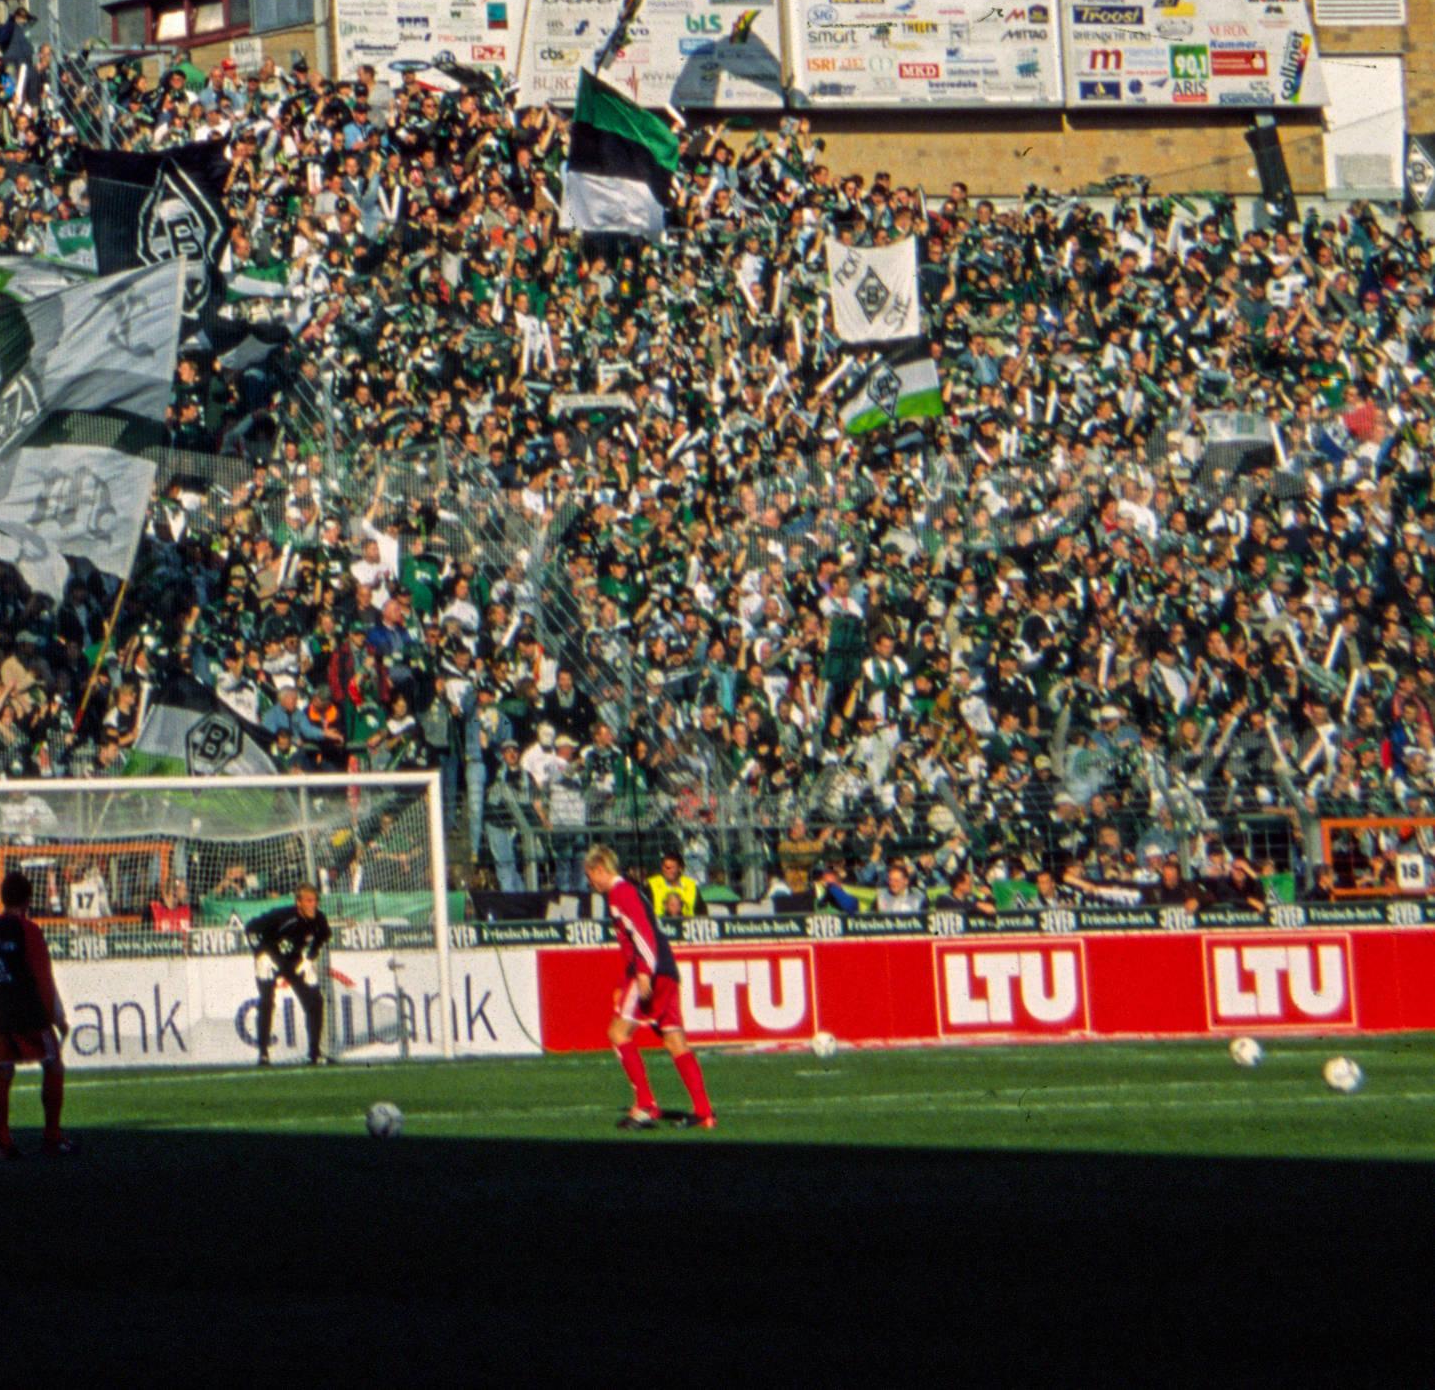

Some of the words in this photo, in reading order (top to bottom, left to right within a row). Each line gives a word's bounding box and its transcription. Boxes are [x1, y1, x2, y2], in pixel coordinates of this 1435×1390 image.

[808, 29, 857, 44] smart
[903, 65, 938, 77] MKD
[68, 933, 108, 959] JEVER
[191, 929, 236, 955] JEVER
[340, 924, 385, 950] JEVER
[565, 921, 604, 945] JEVER
[682, 918, 721, 942] JEVER
[805, 914, 842, 938] JEVER
[928, 912, 964, 935] JEVER
[1040, 910, 1076, 933] JEVER
[1269, 905, 1305, 928] JEVER
[1386, 900, 1422, 924] JEVER
[678, 959, 807, 1032] LTU
[943, 950, 1080, 1025] LTU
[1213, 944, 1345, 1018] LTU
